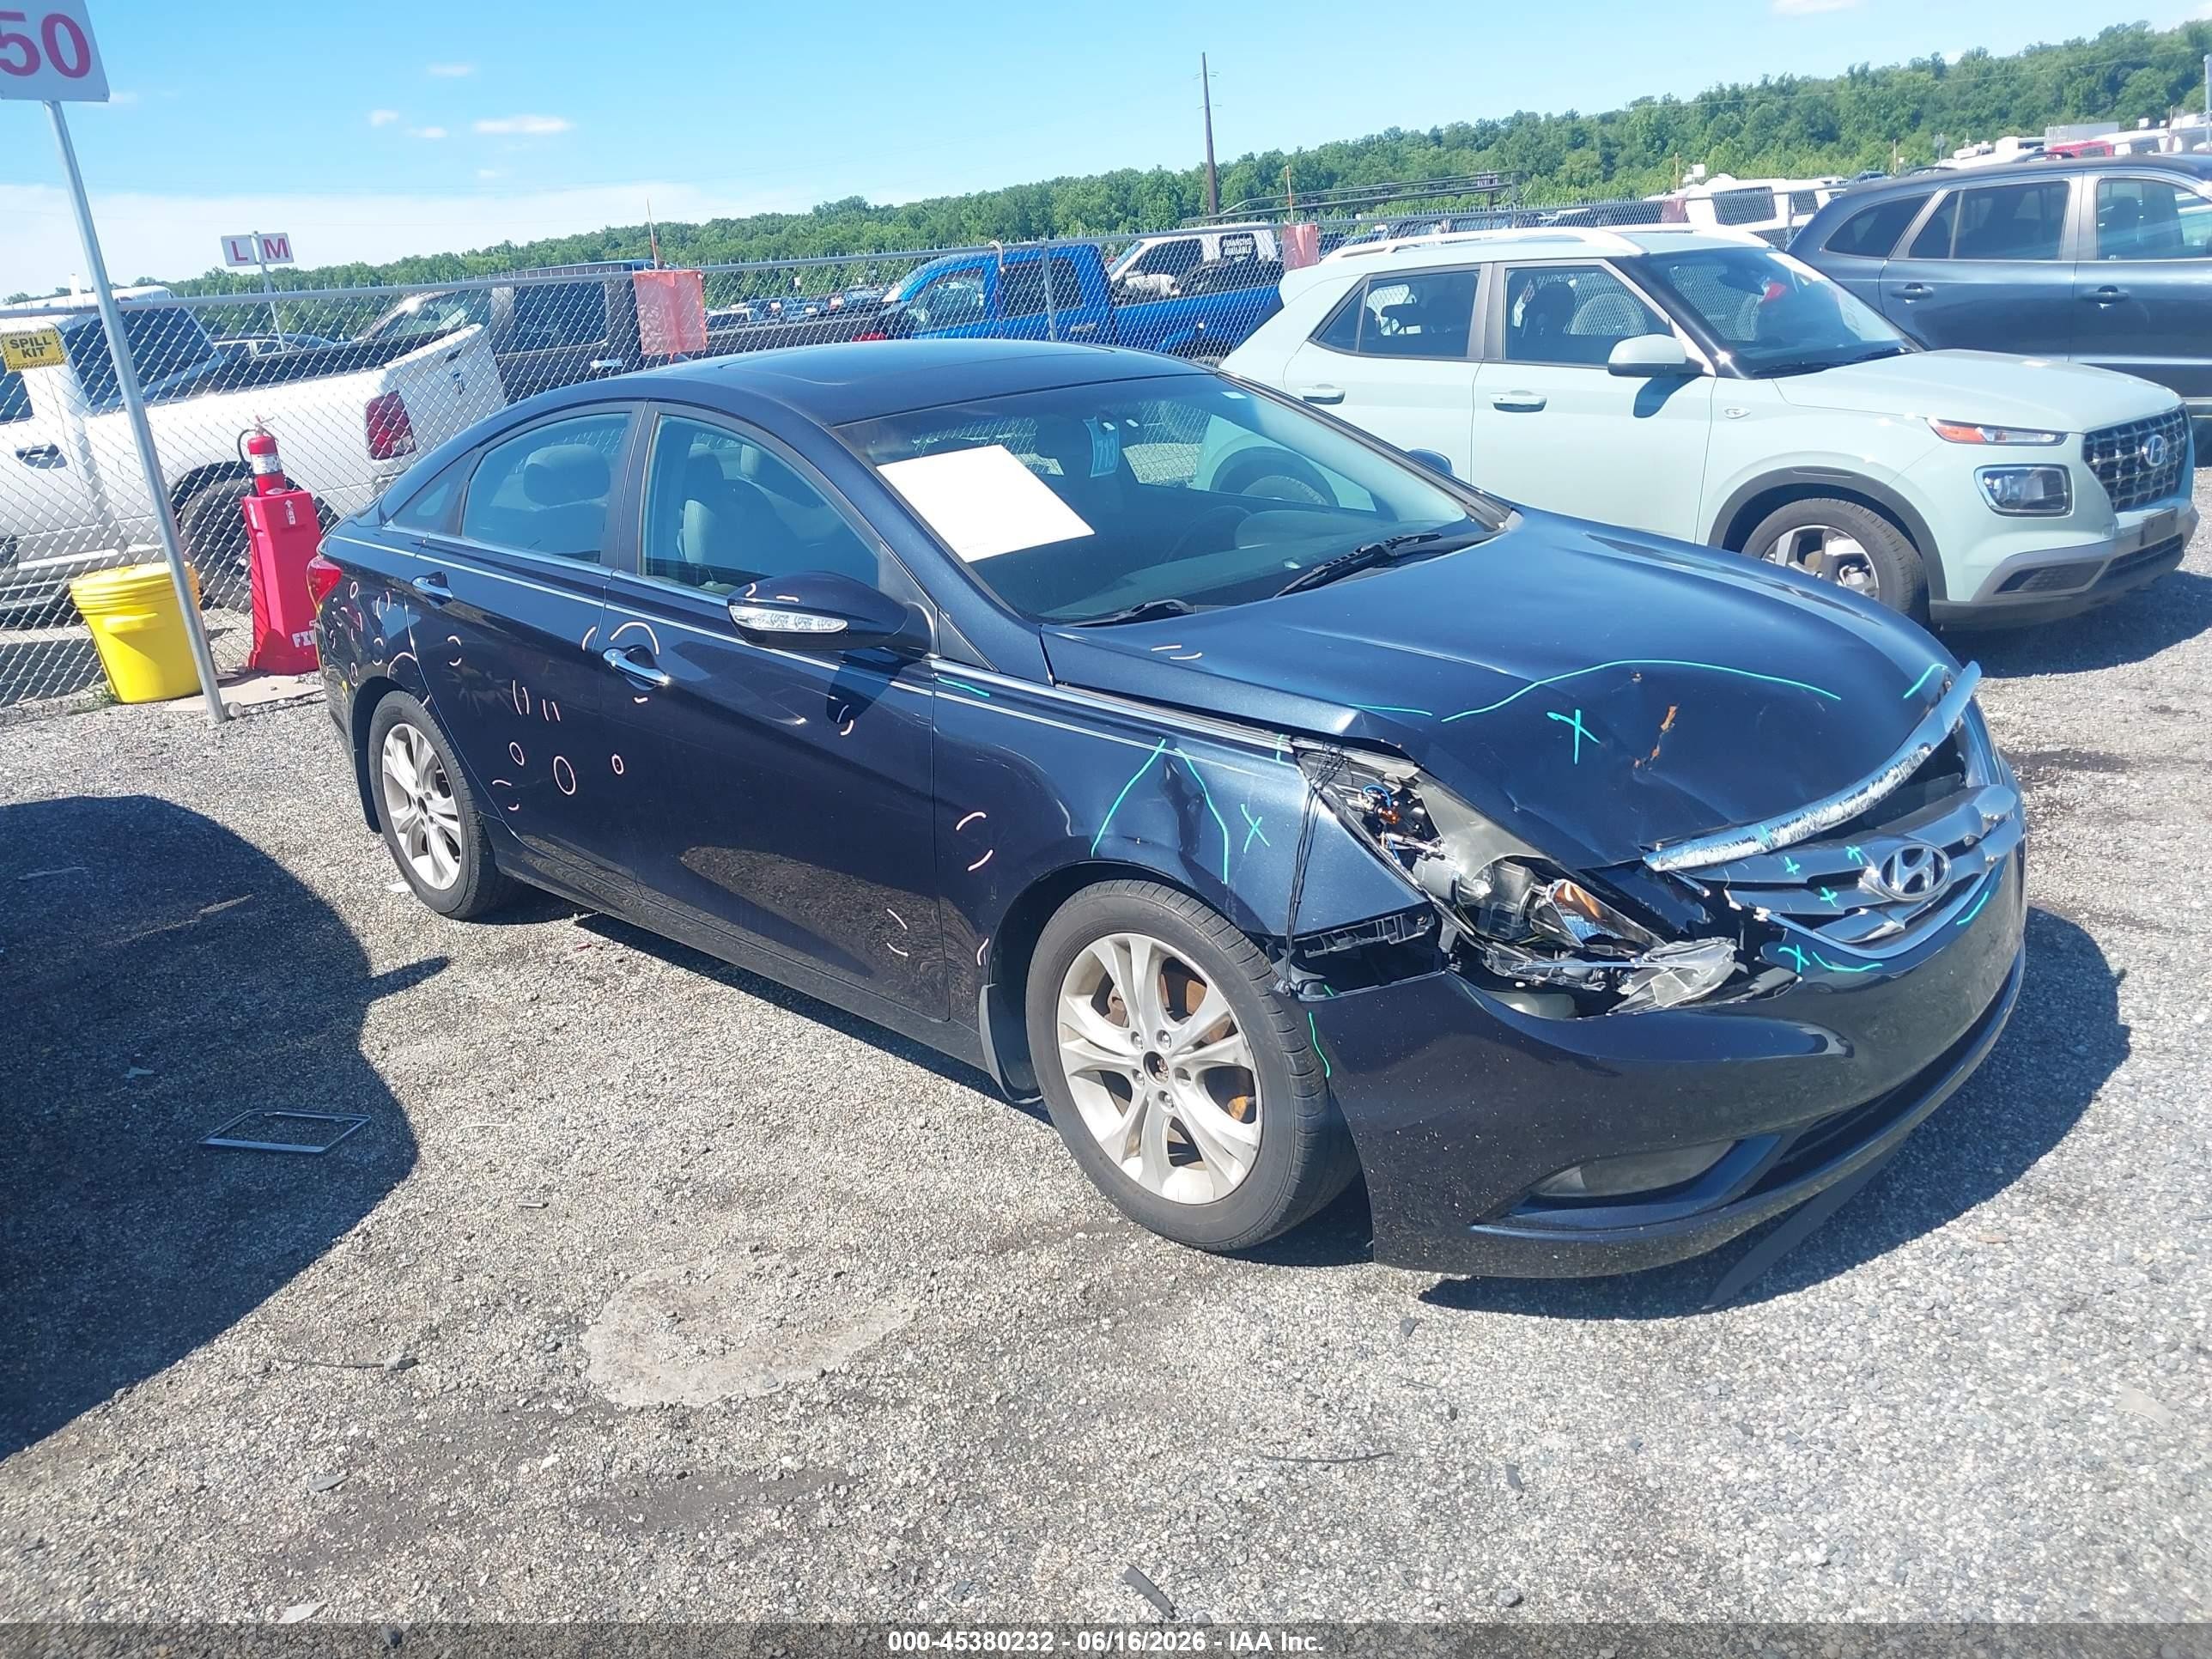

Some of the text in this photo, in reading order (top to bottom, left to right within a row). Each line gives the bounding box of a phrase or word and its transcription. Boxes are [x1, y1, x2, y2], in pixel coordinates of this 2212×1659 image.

[0, 10, 91, 78] 50
[231, 240, 248, 261] L
[263, 238, 289, 259] M
[9, 336, 52, 349] SPILL
[21, 346, 45, 359] KIT
